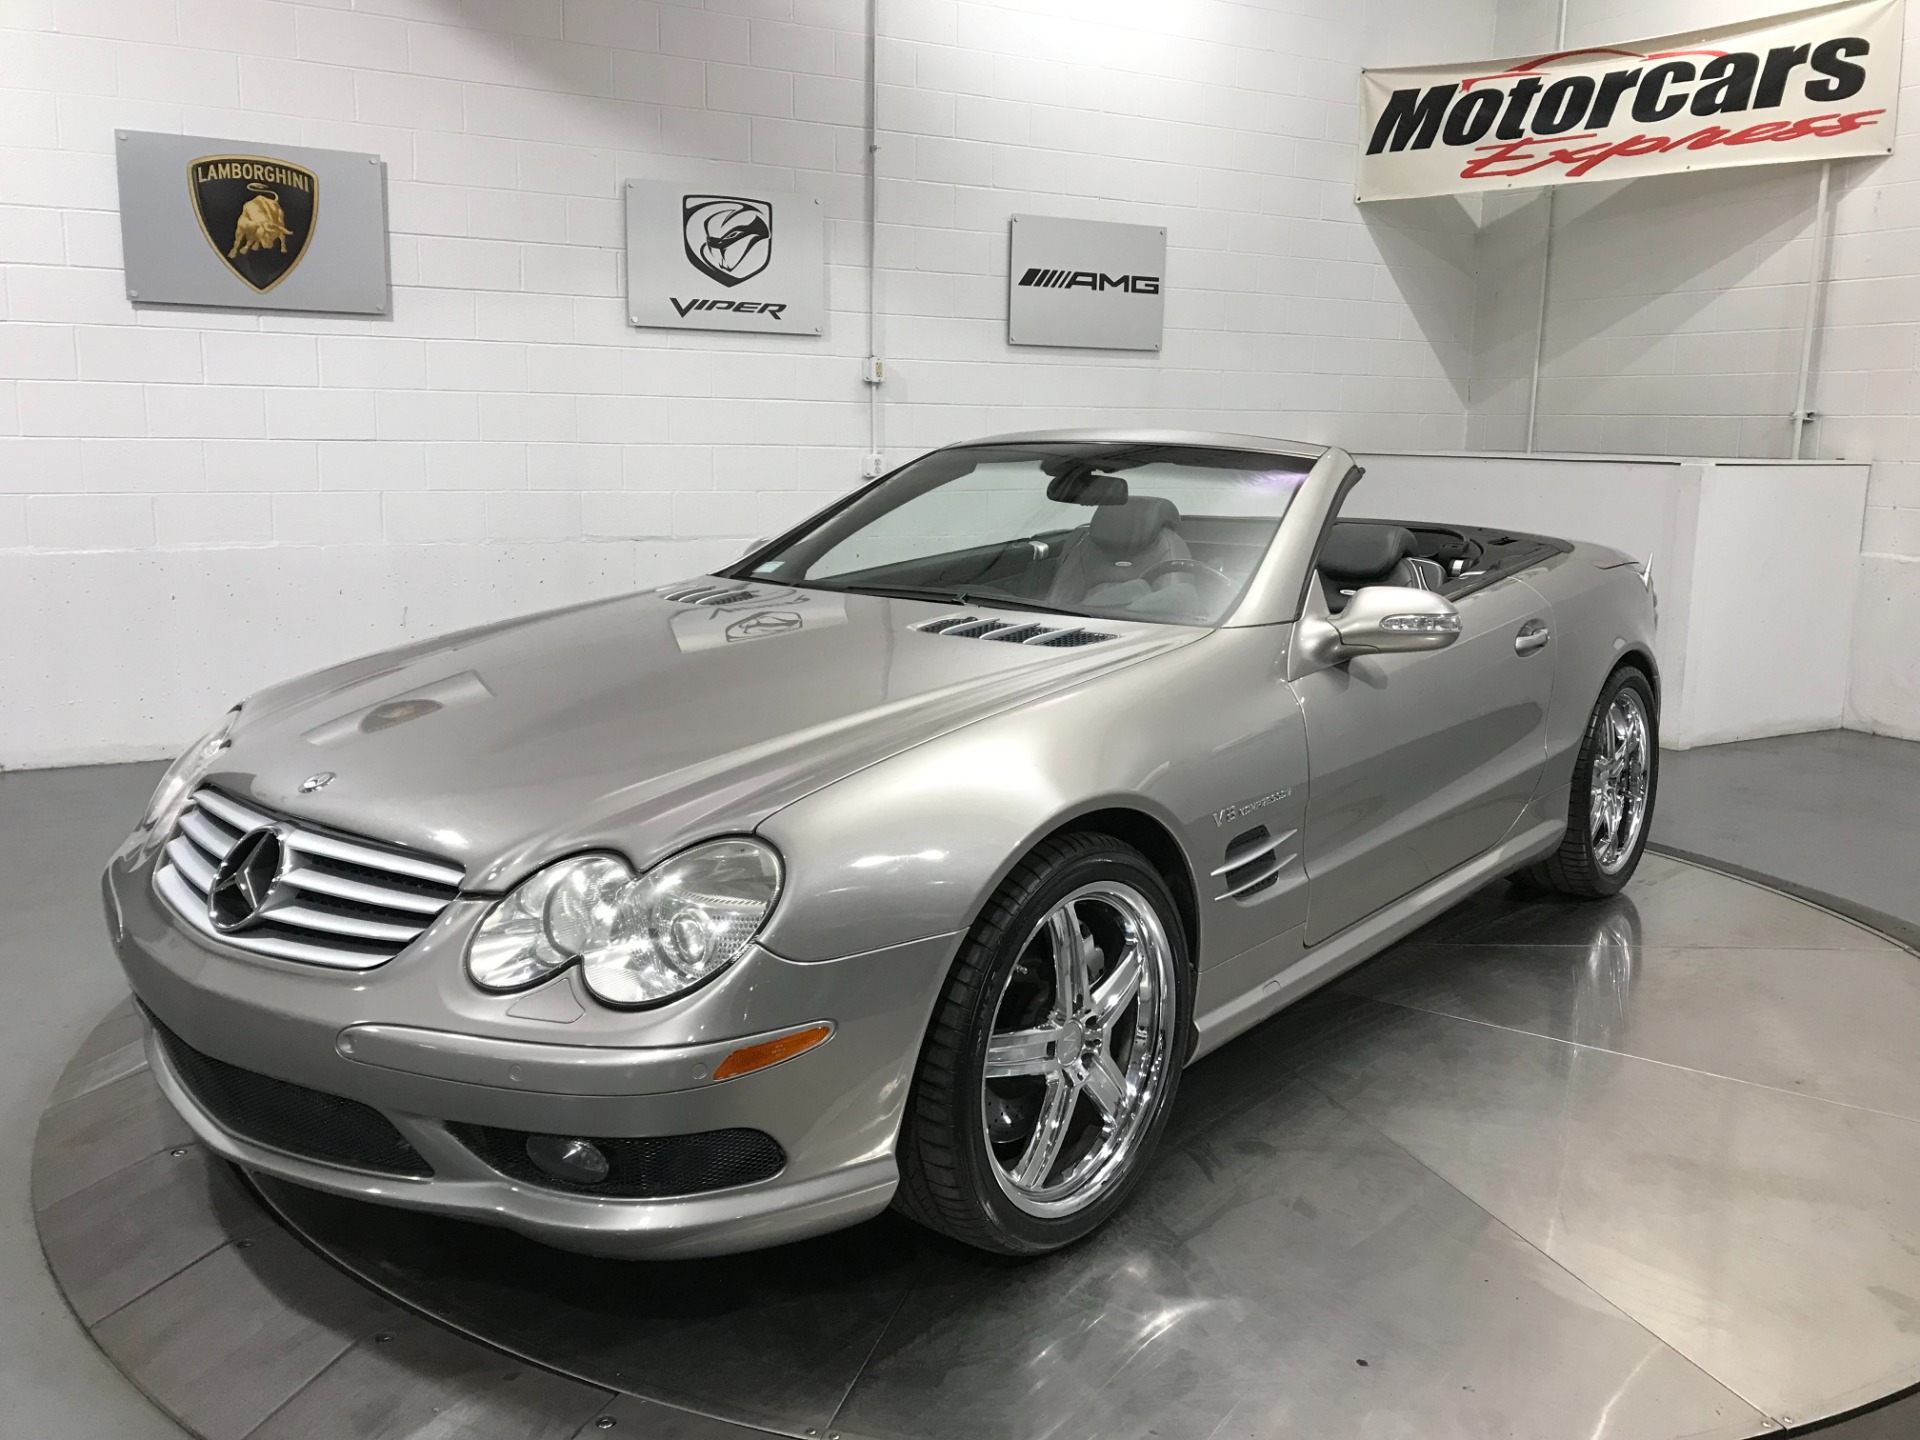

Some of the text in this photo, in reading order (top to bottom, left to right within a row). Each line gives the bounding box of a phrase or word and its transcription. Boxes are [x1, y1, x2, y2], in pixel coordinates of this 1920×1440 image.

[1366, 37, 1869, 155] Motorcars
[1459, 109, 1886, 179] Express
[197, 163, 309, 193] LAMBORGHINI
[1064, 271, 1160, 295] AMG
[669, 297, 787, 320] VIPER
[1212, 805, 1236, 828] V8
